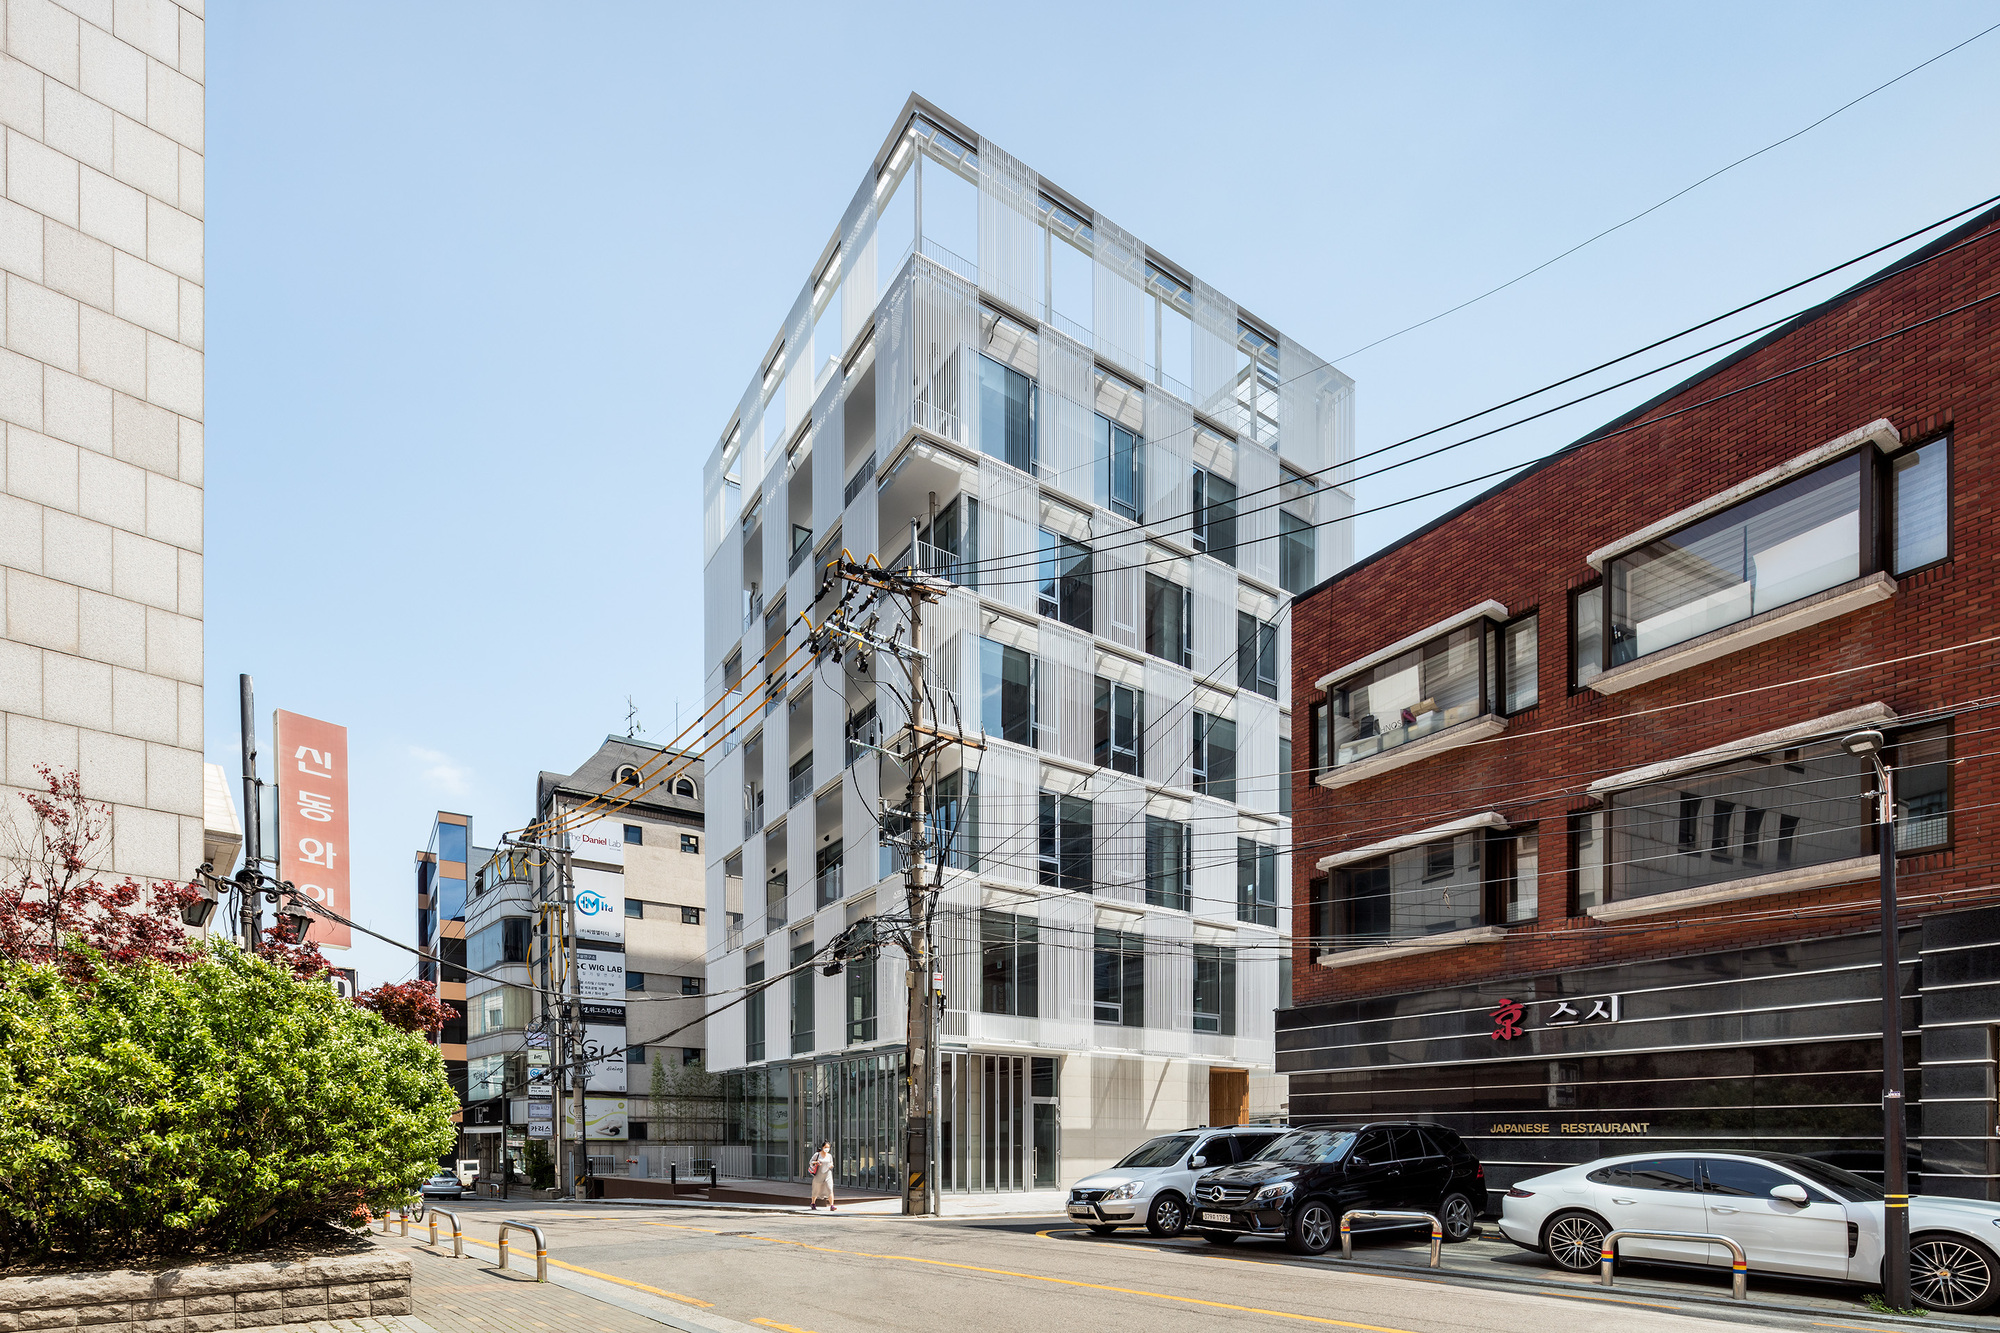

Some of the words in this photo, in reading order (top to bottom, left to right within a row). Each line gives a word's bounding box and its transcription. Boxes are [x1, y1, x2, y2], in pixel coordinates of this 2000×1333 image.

[582, 834, 607, 846] Daniel
[608, 838, 622, 848] Lab
[588, 963, 605, 972] WIG
[607, 965, 623, 974] LAB
[1489, 998, 1525, 1040] 京
[1545, 995, 1619, 1026] 스시
[605, 1065, 624, 1074] dining
[530, 1125, 551, 1133] 카리스
[1489, 1123, 1550, 1134] JAPANESE
[1560, 1122, 1650, 1134] RESTAURANT
